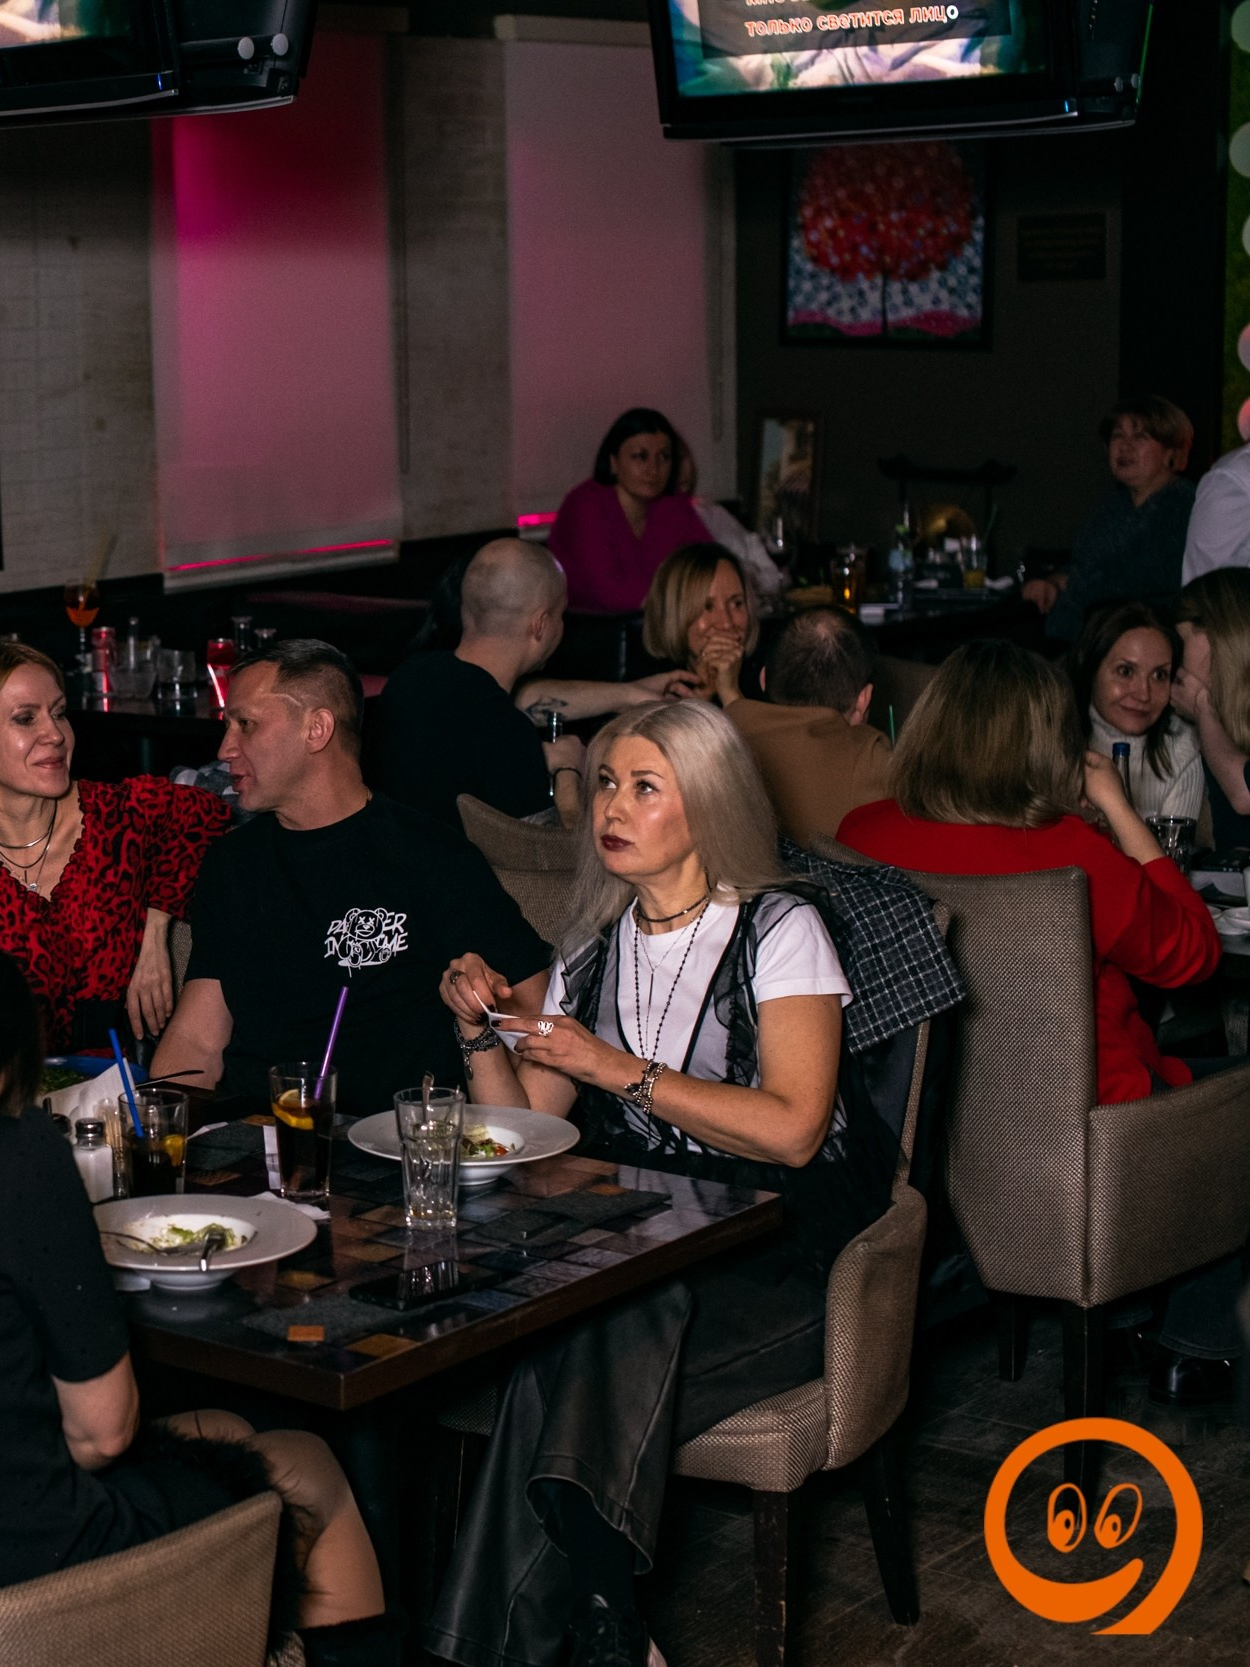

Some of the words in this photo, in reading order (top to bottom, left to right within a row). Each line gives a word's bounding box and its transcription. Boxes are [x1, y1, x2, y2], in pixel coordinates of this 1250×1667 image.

[744, 17, 812, 37] только
[817, 8, 904, 31] светится
[909, 5, 958, 23] лицо
